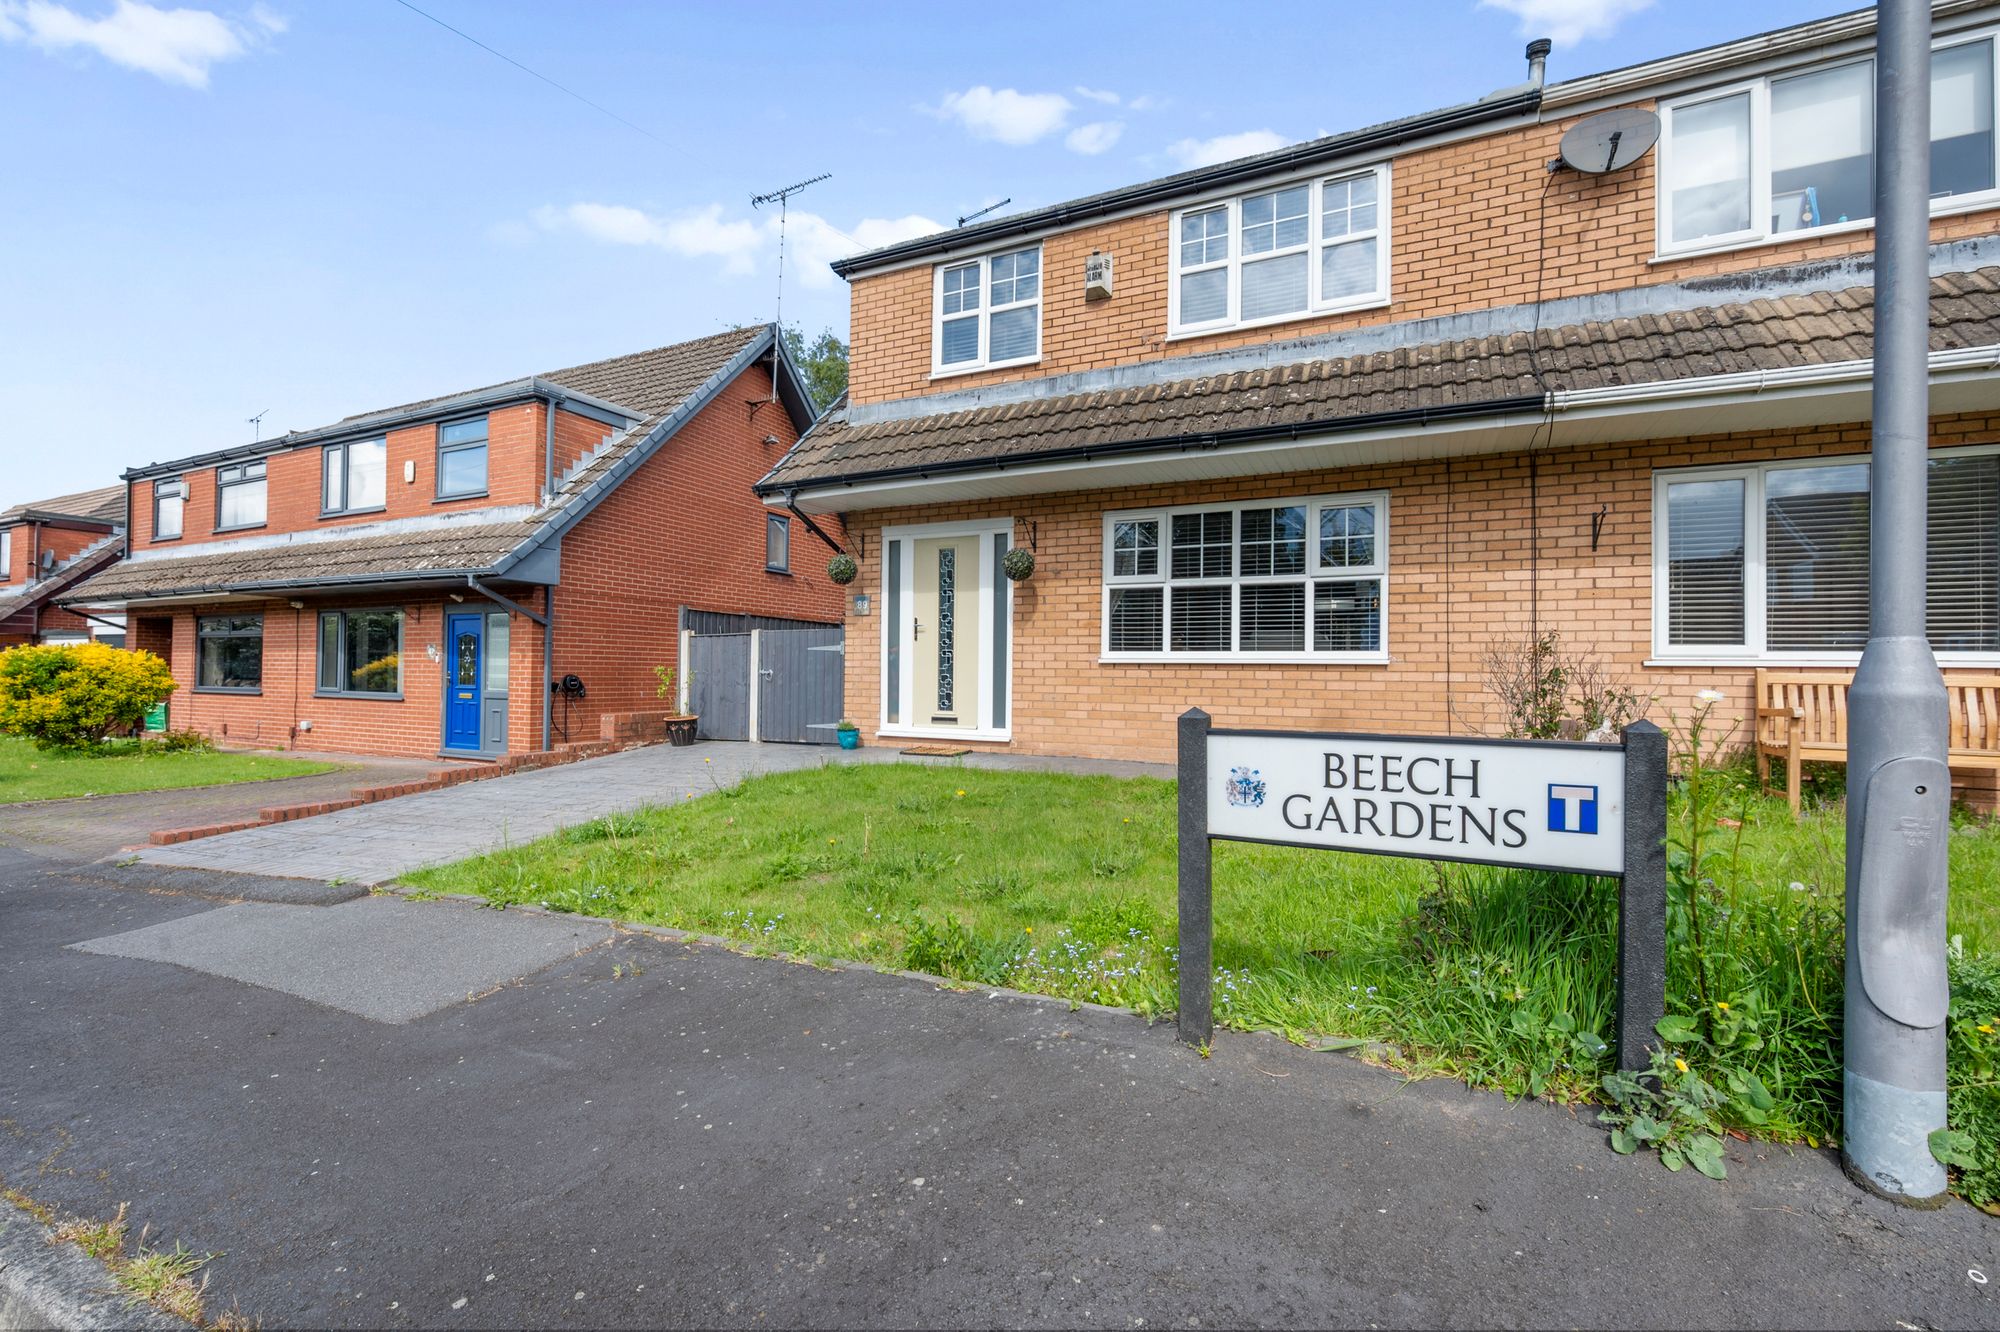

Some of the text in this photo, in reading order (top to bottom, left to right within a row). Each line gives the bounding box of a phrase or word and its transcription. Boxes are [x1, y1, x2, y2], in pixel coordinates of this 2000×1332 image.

[857, 600, 868, 609] 89
[1323, 752, 1481, 799] BEECH
[1282, 794, 1528, 849] GARDENS
